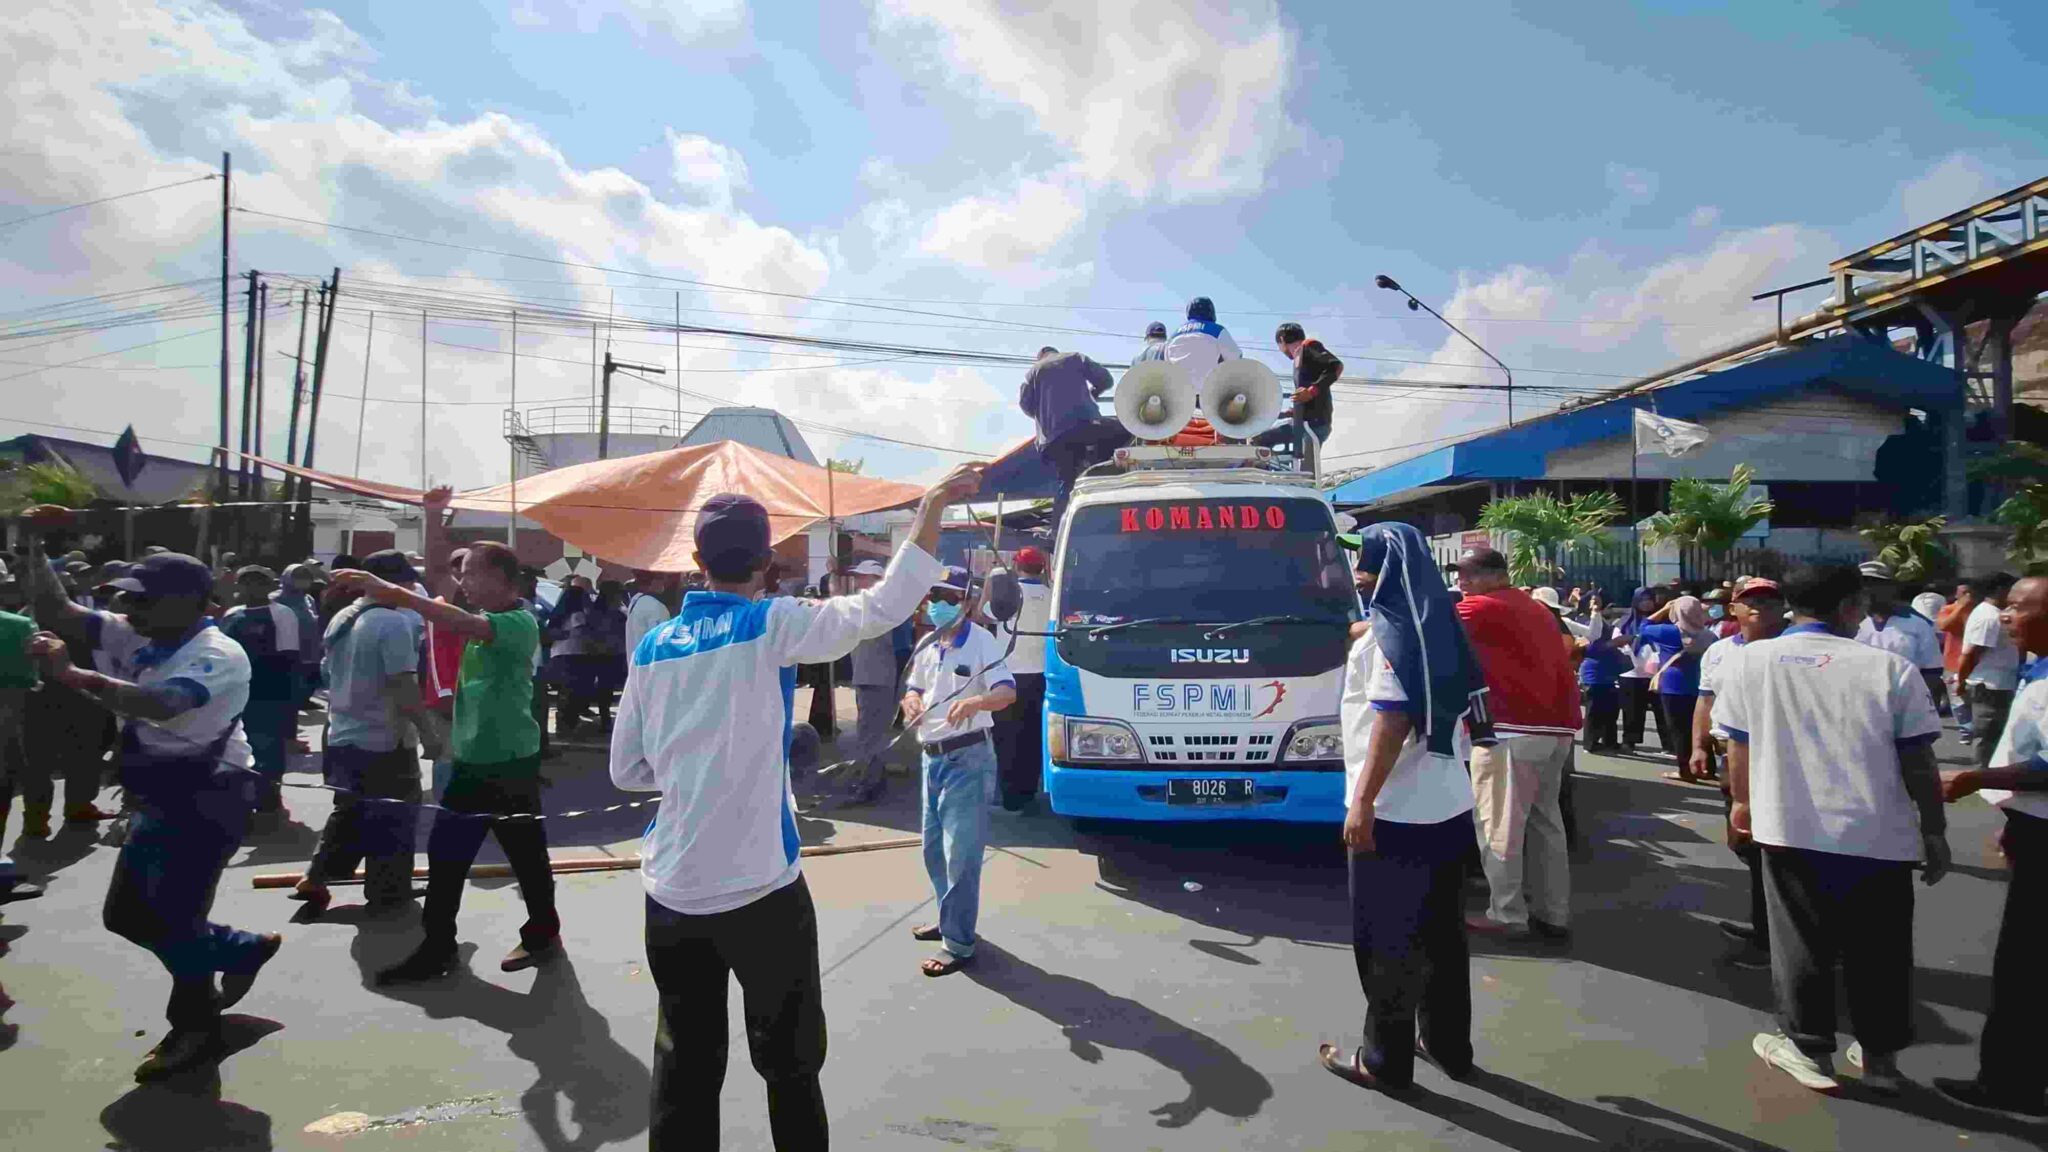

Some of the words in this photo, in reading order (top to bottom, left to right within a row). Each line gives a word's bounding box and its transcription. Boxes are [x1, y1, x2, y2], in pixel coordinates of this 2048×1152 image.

[1119, 504, 1286, 531] KOMANDO
[1171, 648, 1250, 663] ISUZU
[1133, 684, 1251, 711] FSPMI
[1169, 780, 1176, 796] L
[1193, 780, 1226, 796] 8026
[1245, 780, 1253, 796] R
